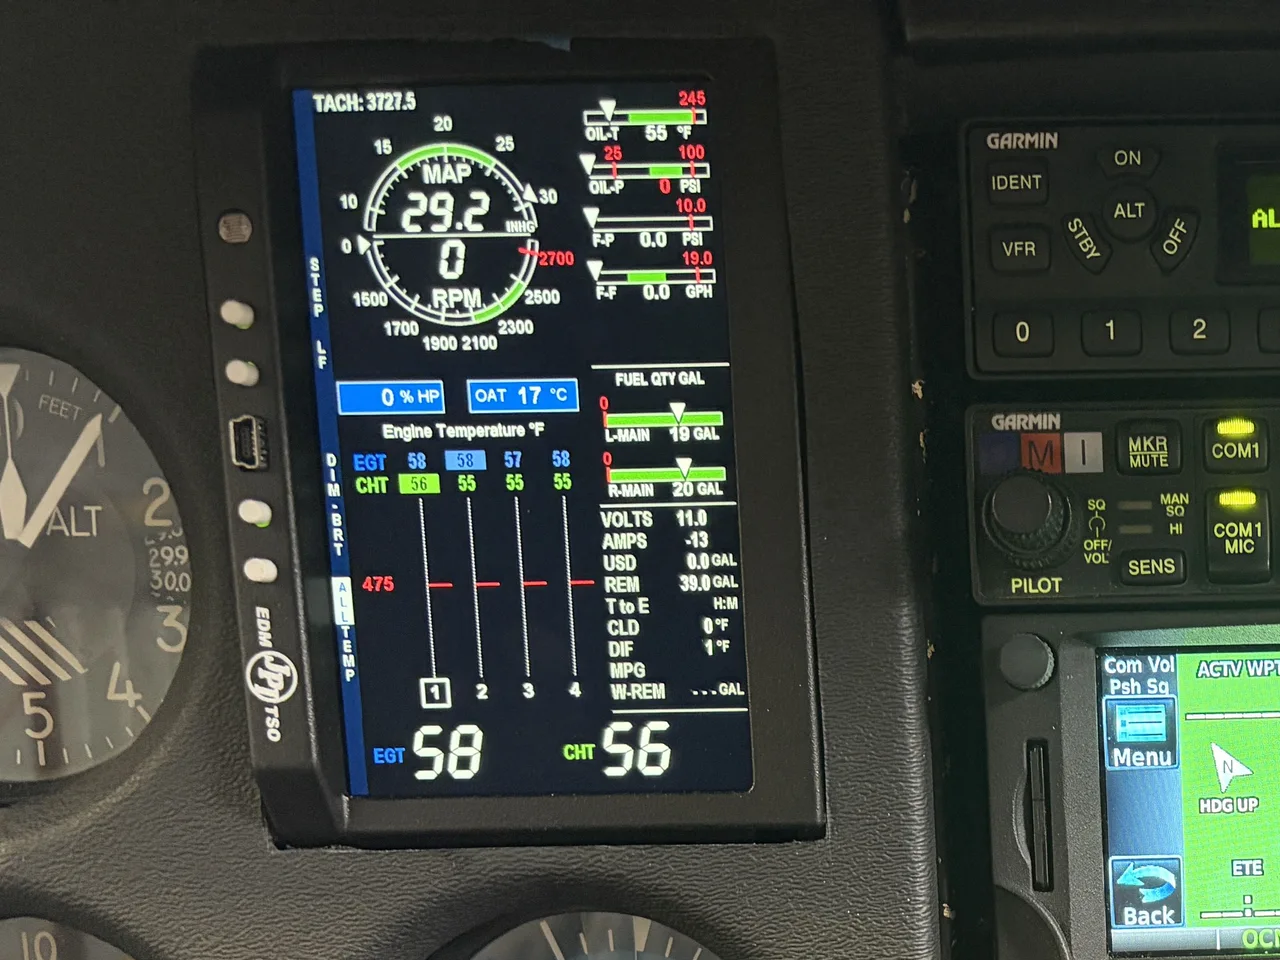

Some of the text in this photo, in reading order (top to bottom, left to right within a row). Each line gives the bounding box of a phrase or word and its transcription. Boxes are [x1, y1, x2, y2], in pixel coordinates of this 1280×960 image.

[313, 94, 416, 112] TACH: 3727.5
[585, 126, 667, 142] OIL-T 55
[987, 132, 1058, 149] GARMIN
[423, 164, 471, 184] MAP
[992, 175, 1041, 190] IDENT
[401, 192, 490, 232] 29.2
[1114, 204, 1144, 218] ALT
[1163, 218, 1187, 255] OFF
[1003, 242, 1035, 256] VFR
[539, 252, 574, 265] 2700
[353, 292, 387, 307] 1500
[432, 289, 481, 308] RPM
[525, 290, 560, 305] 2500
[462, 336, 497, 350] 2100
[616, 370, 705, 387] FUEL QTY GAL
[475, 389, 507, 403] OAT
[38, 394, 83, 422] FEET
[992, 414, 1060, 430] GARMIN
[382, 422, 525, 441] Engine Temperature
[605, 428, 650, 443] L-MAIN
[1129, 437, 1167, 451] MKR
[1212, 444, 1259, 459] COM1
[1130, 454, 1168, 468] MUTE
[608, 483, 654, 497] R-MAIN
[47, 505, 102, 537] ALT
[600, 510, 707, 527] VOLTS 11.0
[602, 533, 647, 549] AMPS
[1225, 539, 1254, 554] MIC
[1129, 559, 1175, 575] SENS
[362, 577, 394, 591] 475
[605, 575, 710, 593] REM 39.0
[1011, 577, 1062, 593] PILOT
[255, 607, 273, 648] EDM
[1105, 655, 1174, 674] Com Vol
[1197, 660, 1243, 678] ACTV
[1110, 679, 1142, 694] Psh
[267, 705, 282, 743] TSO
[373, 725, 483, 779] EGT 58
[564, 721, 670, 776] CHT 56
[1114, 750, 1171, 766] Menu
[1200, 798, 1258, 813] HDG UP
[1232, 859, 1264, 876] ETE
[1124, 906, 1174, 925] Back
